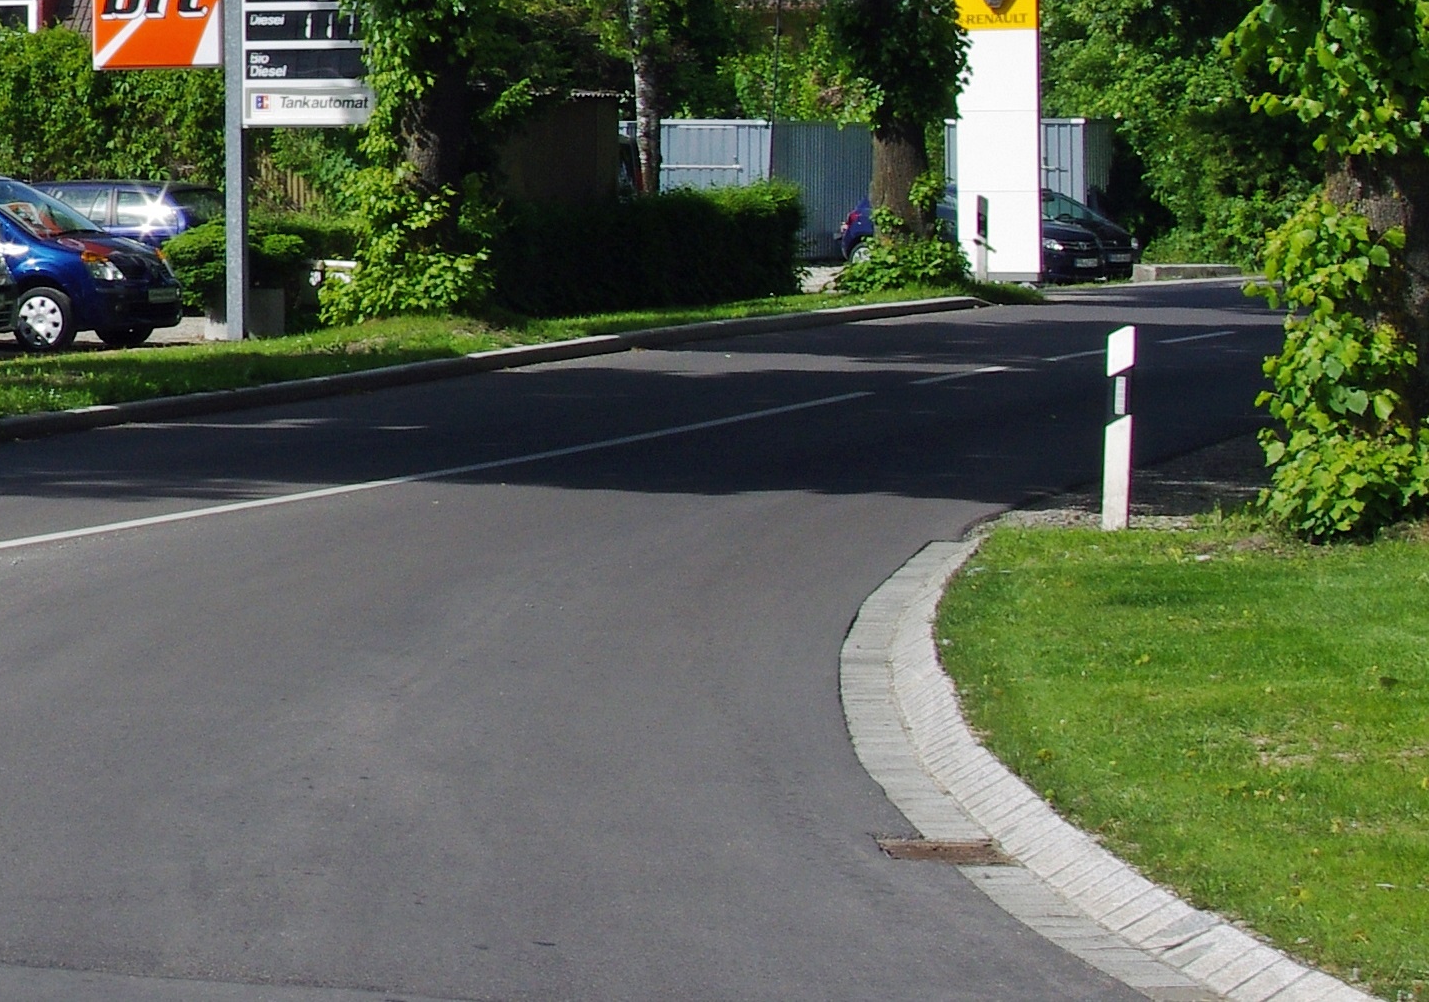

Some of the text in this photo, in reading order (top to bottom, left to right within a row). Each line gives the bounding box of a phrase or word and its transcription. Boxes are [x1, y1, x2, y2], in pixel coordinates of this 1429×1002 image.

[249, 14, 285, 26] Diesel
[966, 13, 1028, 25] RENAULT
[249, 53, 270, 64] Bio
[249, 65, 287, 77] Diesel
[280, 95, 369, 109] Tankautomat
